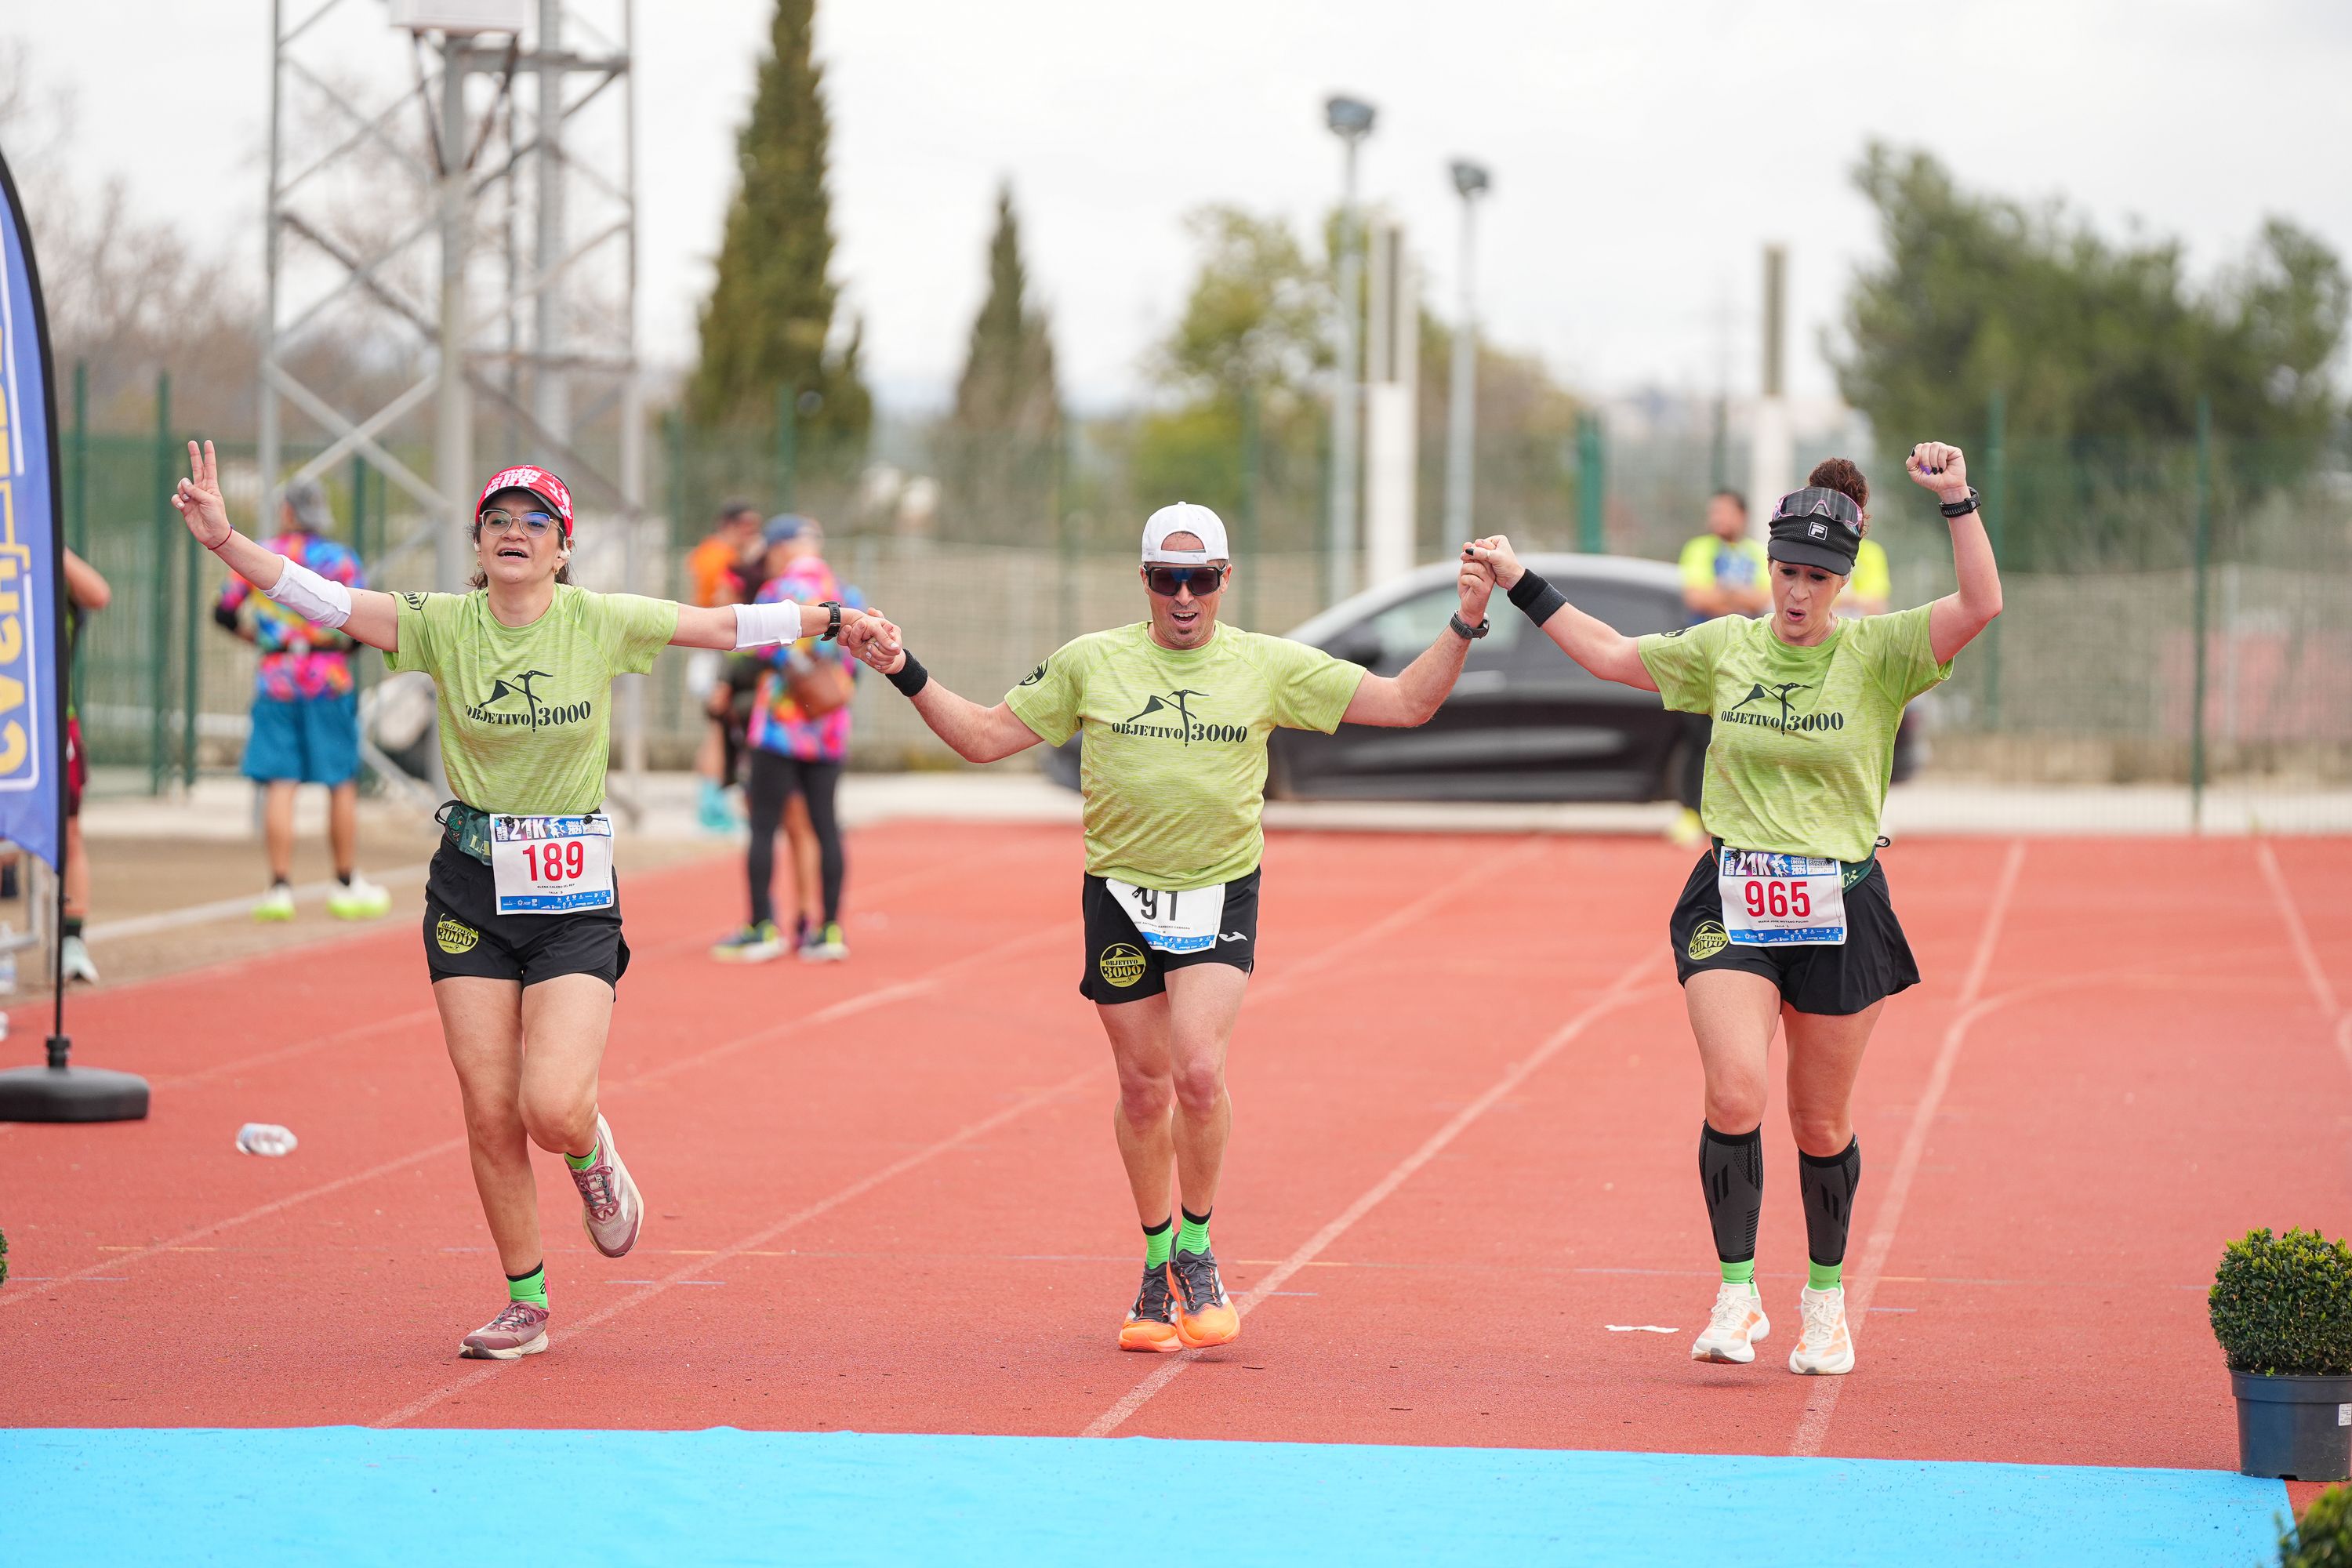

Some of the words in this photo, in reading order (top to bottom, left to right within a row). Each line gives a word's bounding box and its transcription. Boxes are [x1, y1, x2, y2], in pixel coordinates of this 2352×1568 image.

[465, 705, 531, 726] OBJETIVO
[538, 701, 591, 726] 3000
[1721, 710, 1780, 728] OBJETIVO
[1786, 712, 1844, 731] 3000
[1112, 722, 1184, 739] OBJETIVO
[1191, 723, 1247, 743] 3000
[510, 818, 547, 840] 21K
[522, 841, 583, 881] 189
[1735, 851, 1771, 876] 21K
[1140, 889, 1178, 921] 91
[1744, 880, 1810, 917] 965
[438, 928, 472, 946] 3000
[1690, 940, 1723, 956] 3000
[1104, 965, 1141, 978] 3000
